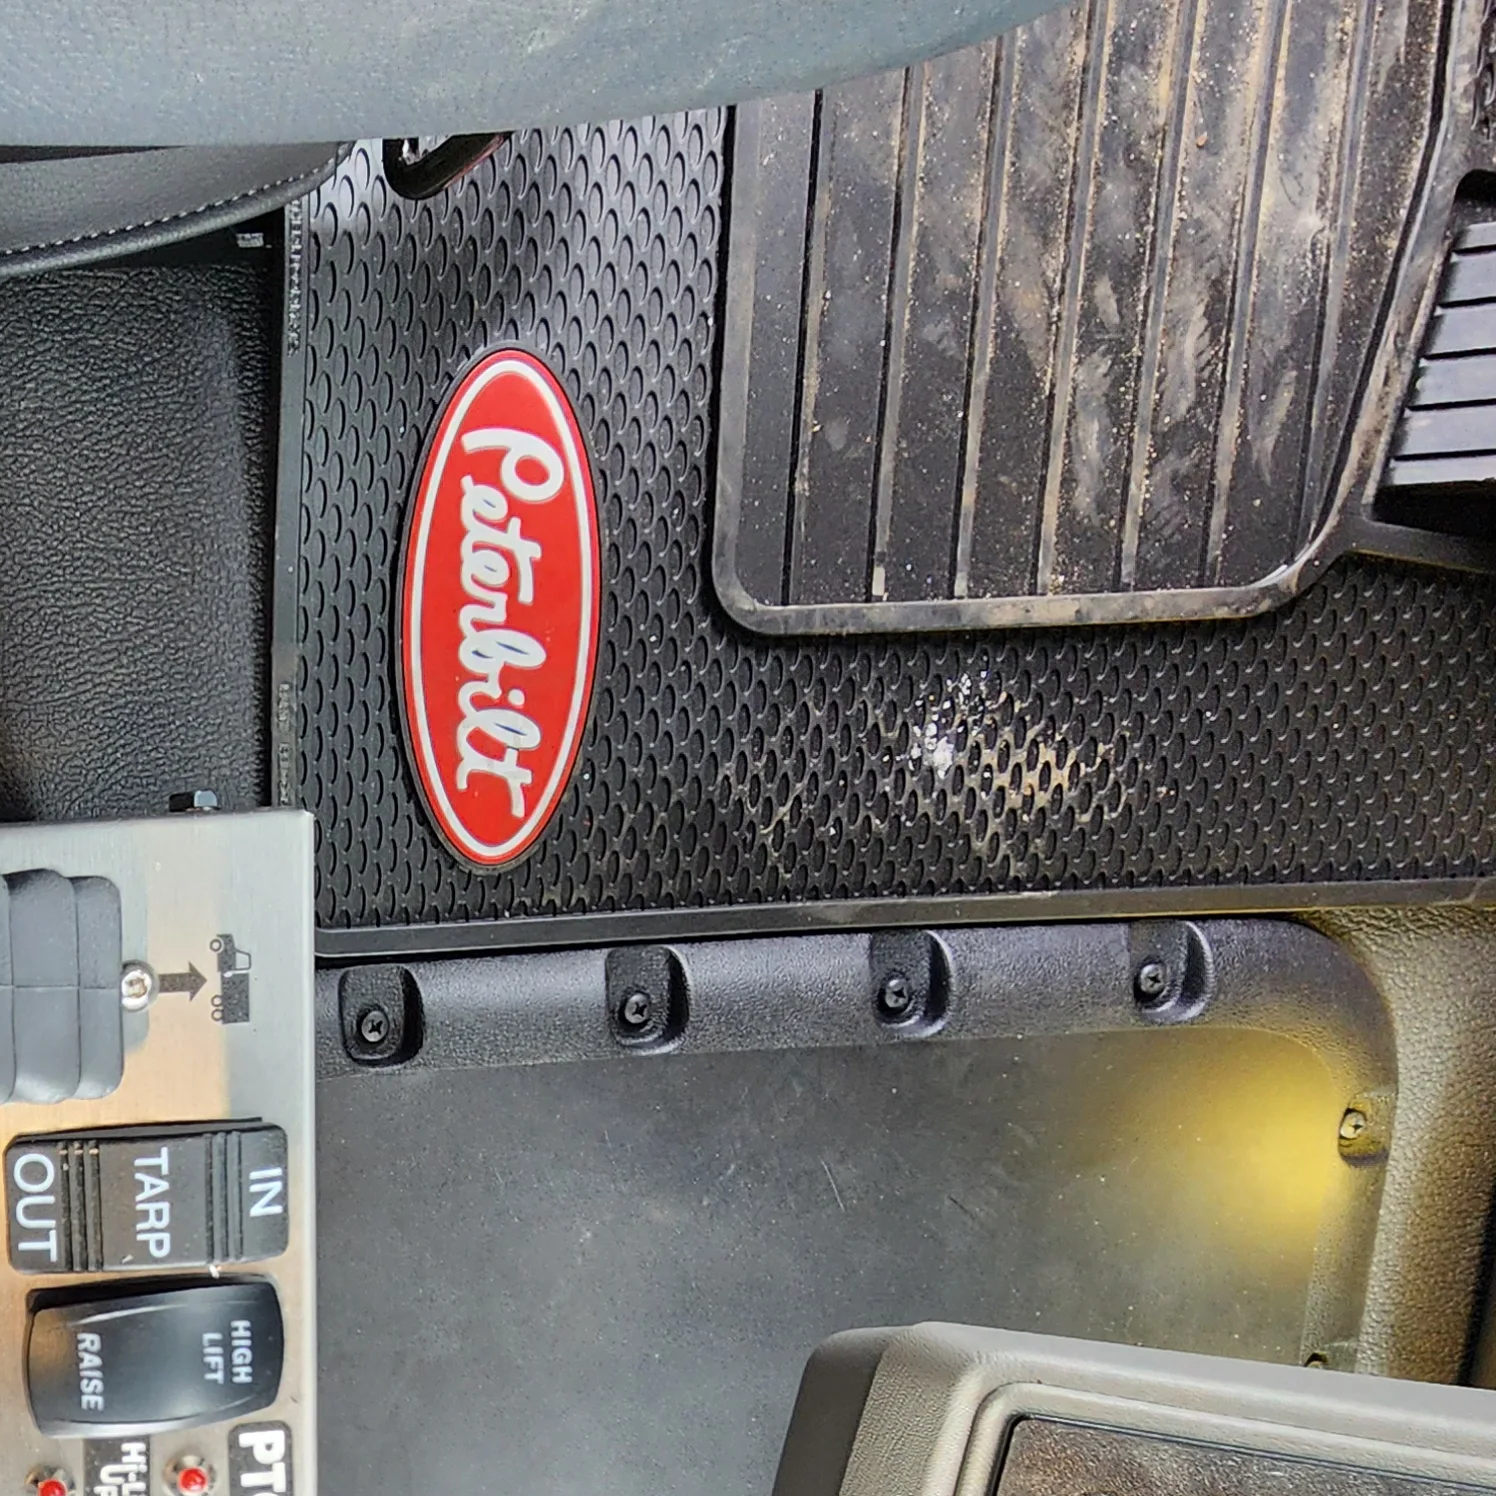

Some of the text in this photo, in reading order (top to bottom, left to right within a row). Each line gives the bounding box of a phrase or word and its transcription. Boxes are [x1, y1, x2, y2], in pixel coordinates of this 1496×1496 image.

[456, 428, 565, 819] Peterbilt
[13, 1153, 57, 1262] OUT
[134, 1147, 170, 1258] TARP
[249, 1167, 284, 1217] IN
[77, 1332, 104, 1412] RAISE
[202, 1332, 224, 1384] LIFT
[230, 1320, 253, 1384] HIGH
